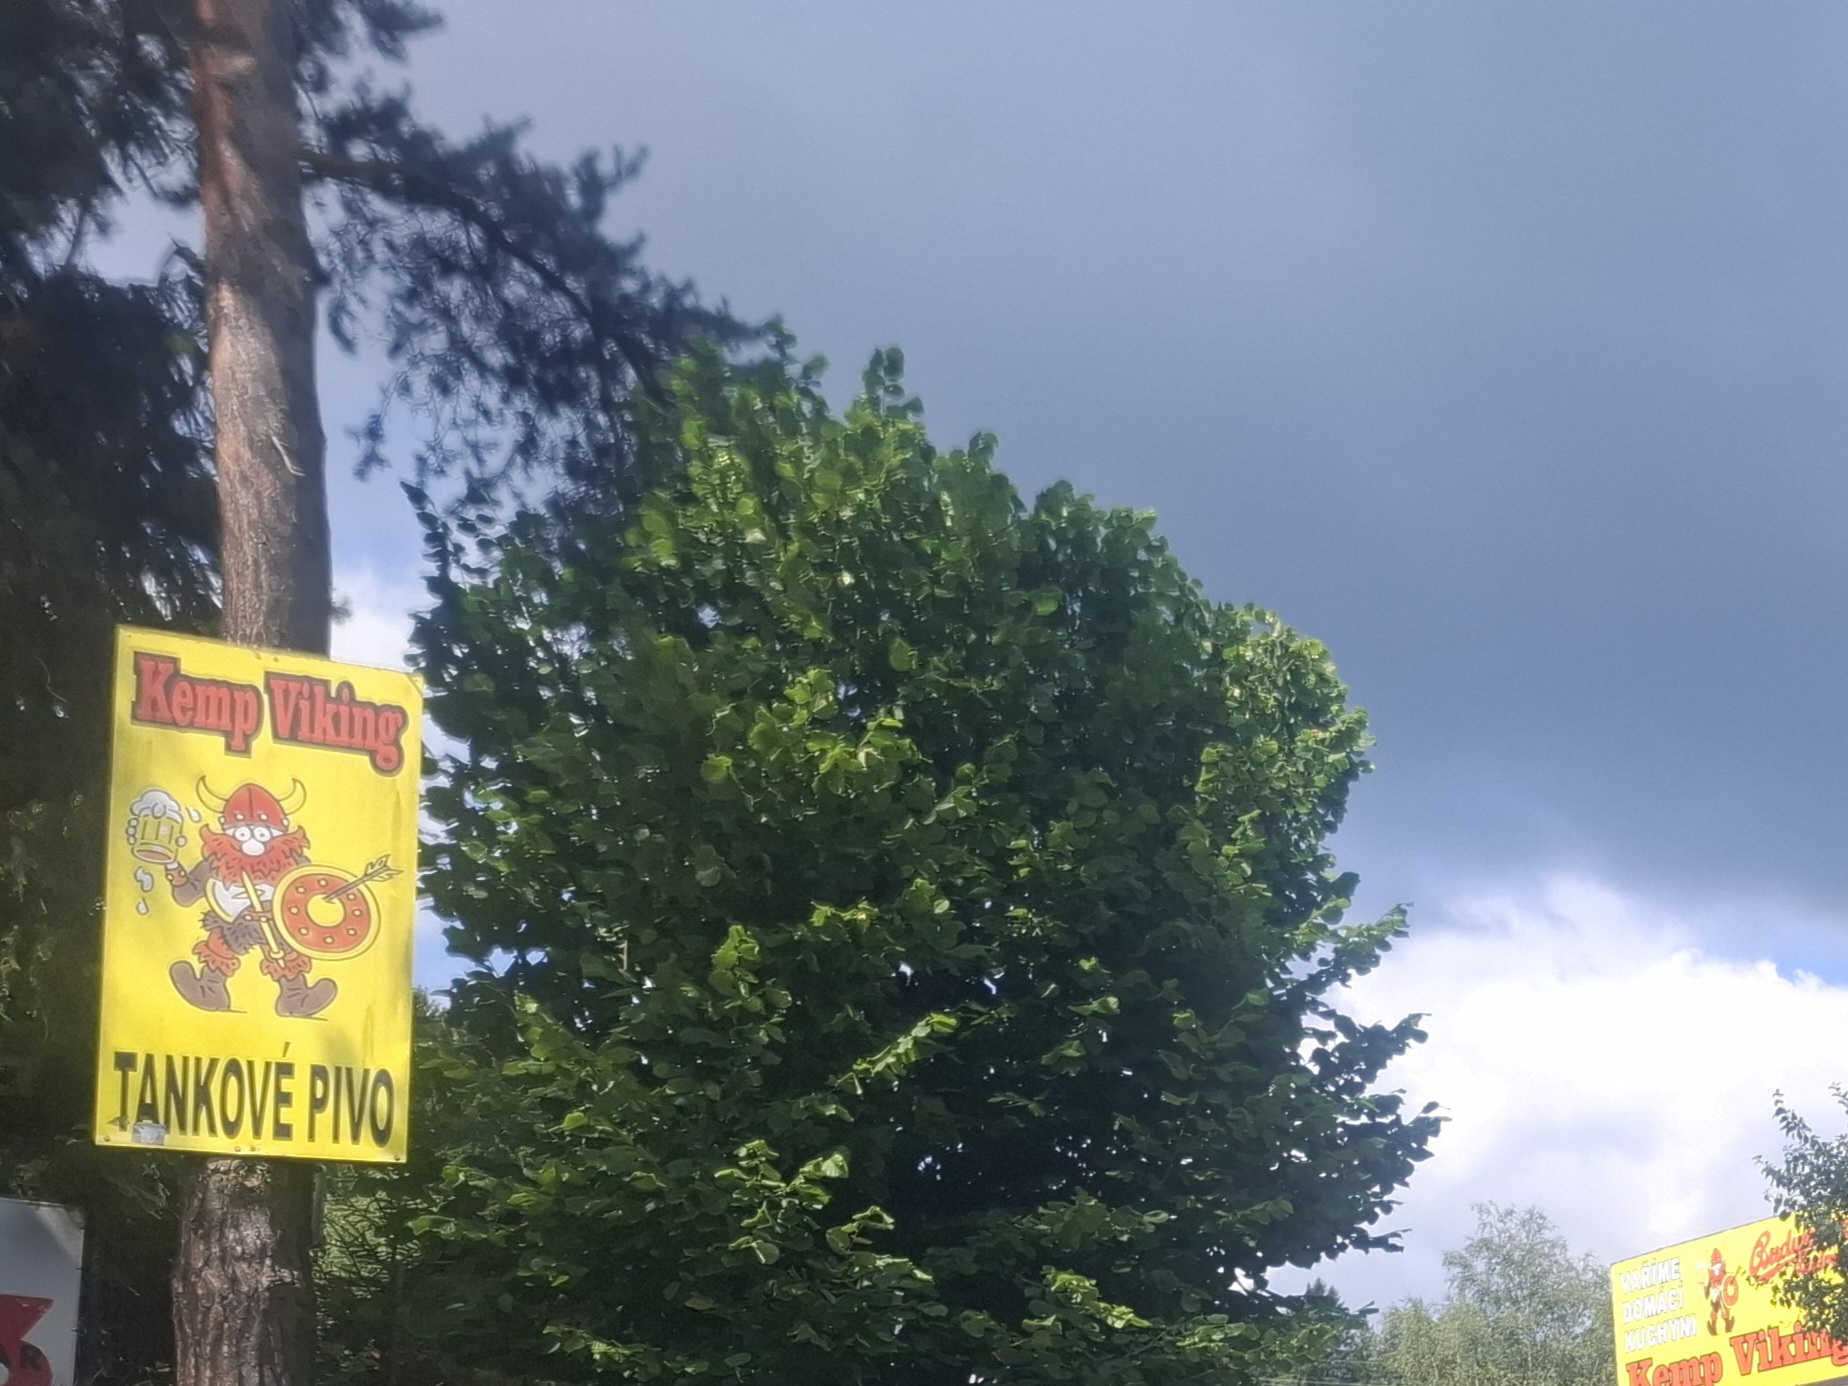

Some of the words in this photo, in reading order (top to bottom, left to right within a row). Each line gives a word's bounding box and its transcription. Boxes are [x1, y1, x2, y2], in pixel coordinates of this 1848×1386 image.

[135, 654, 261, 757] Kemp
[267, 672, 404, 776] Viking
[114, 1041, 295, 1143] TANKOVÉ
[308, 1061, 396, 1148] PIVO
[1620, 1257, 1681, 1294] VAŘÍME
[1622, 1280, 1684, 1324] DOMÁCÍ
